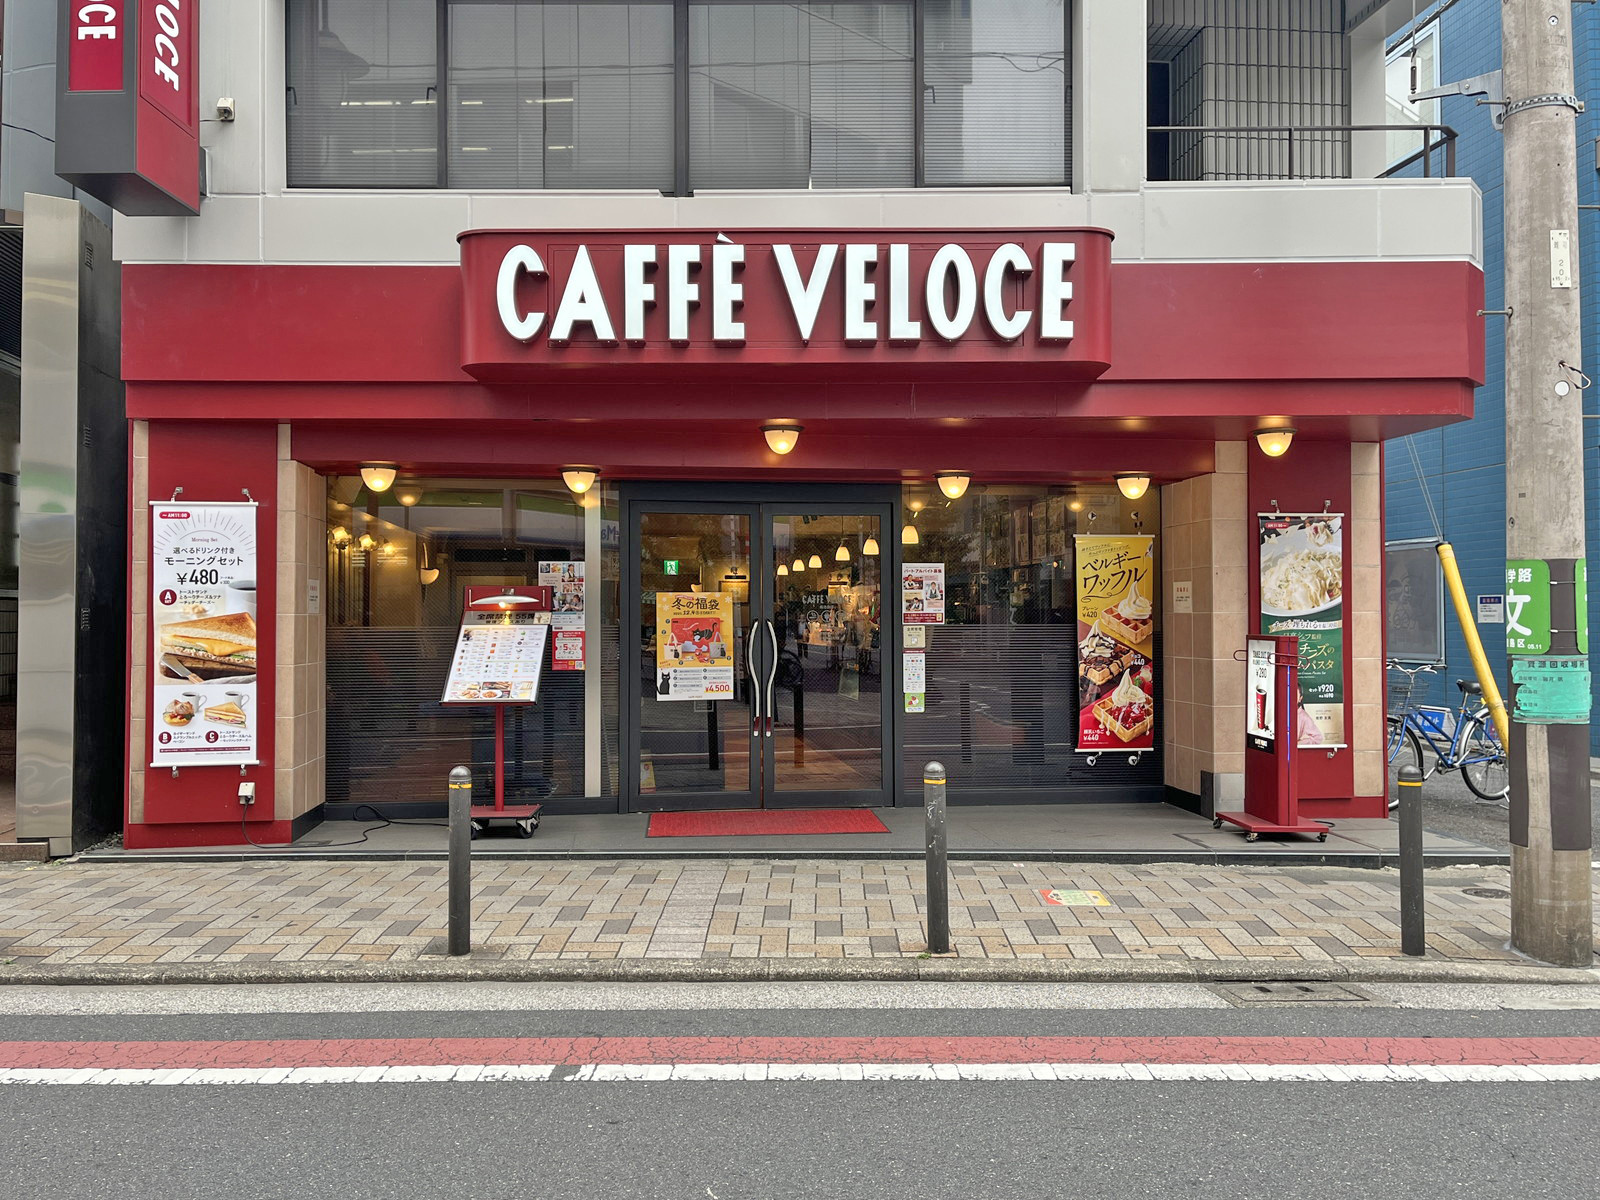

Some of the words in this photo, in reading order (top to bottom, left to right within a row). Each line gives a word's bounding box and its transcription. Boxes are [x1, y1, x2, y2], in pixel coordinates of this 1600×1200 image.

[78, 0, 116, 40] CE
[496, 231, 745, 342] CAFFÈ
[772, 241, 1076, 342] VELOCE
[173, 547, 235, 555] 選べるドリンク付き
[164, 556, 244, 566] モーニングセット
[1082, 551, 1142, 572] ベルギー
[176, 569, 219, 585] ¥480
[1083, 567, 1148, 597] ワッフル
[1506, 568, 1533, 583] 学路
[164, 591, 172, 600] A
[671, 597, 721, 611] 冬の福袋
[1506, 638, 1525, 648] 島区
[1318, 684, 1335, 693] ¥920
